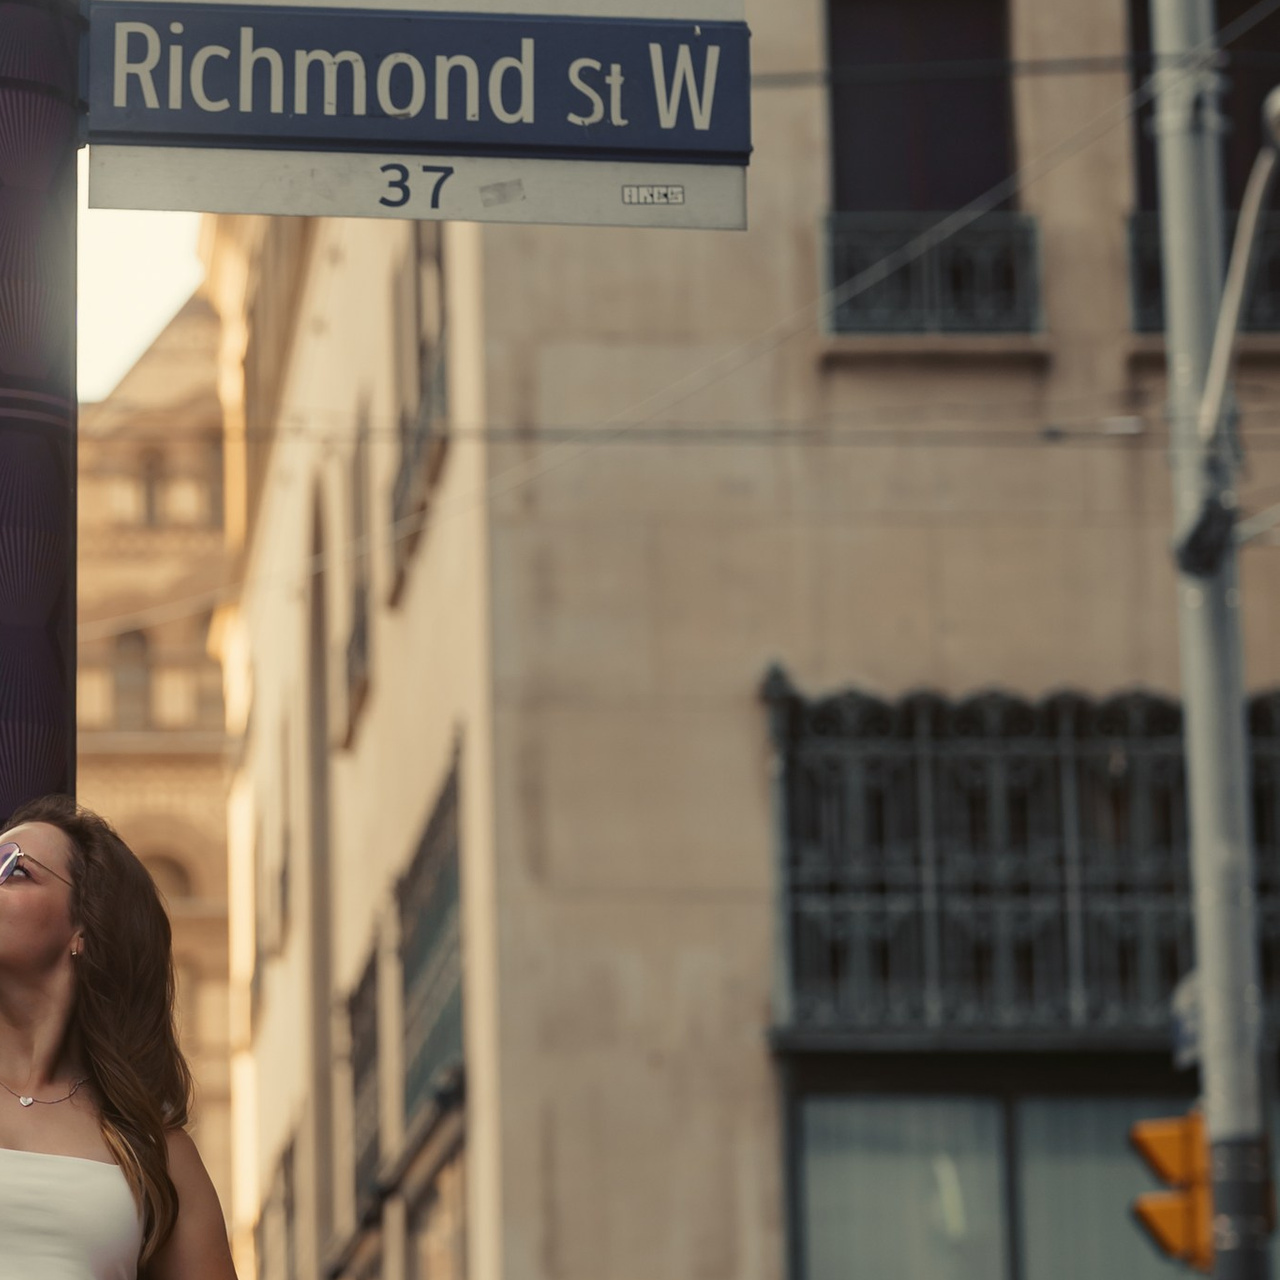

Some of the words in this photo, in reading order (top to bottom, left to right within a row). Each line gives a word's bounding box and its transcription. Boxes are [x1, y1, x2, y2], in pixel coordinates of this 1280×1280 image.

[113, 21, 535, 124] Richmond
[567, 57, 629, 127] St
[648, 42, 721, 131] W
[379, 163, 454, 209] 37
